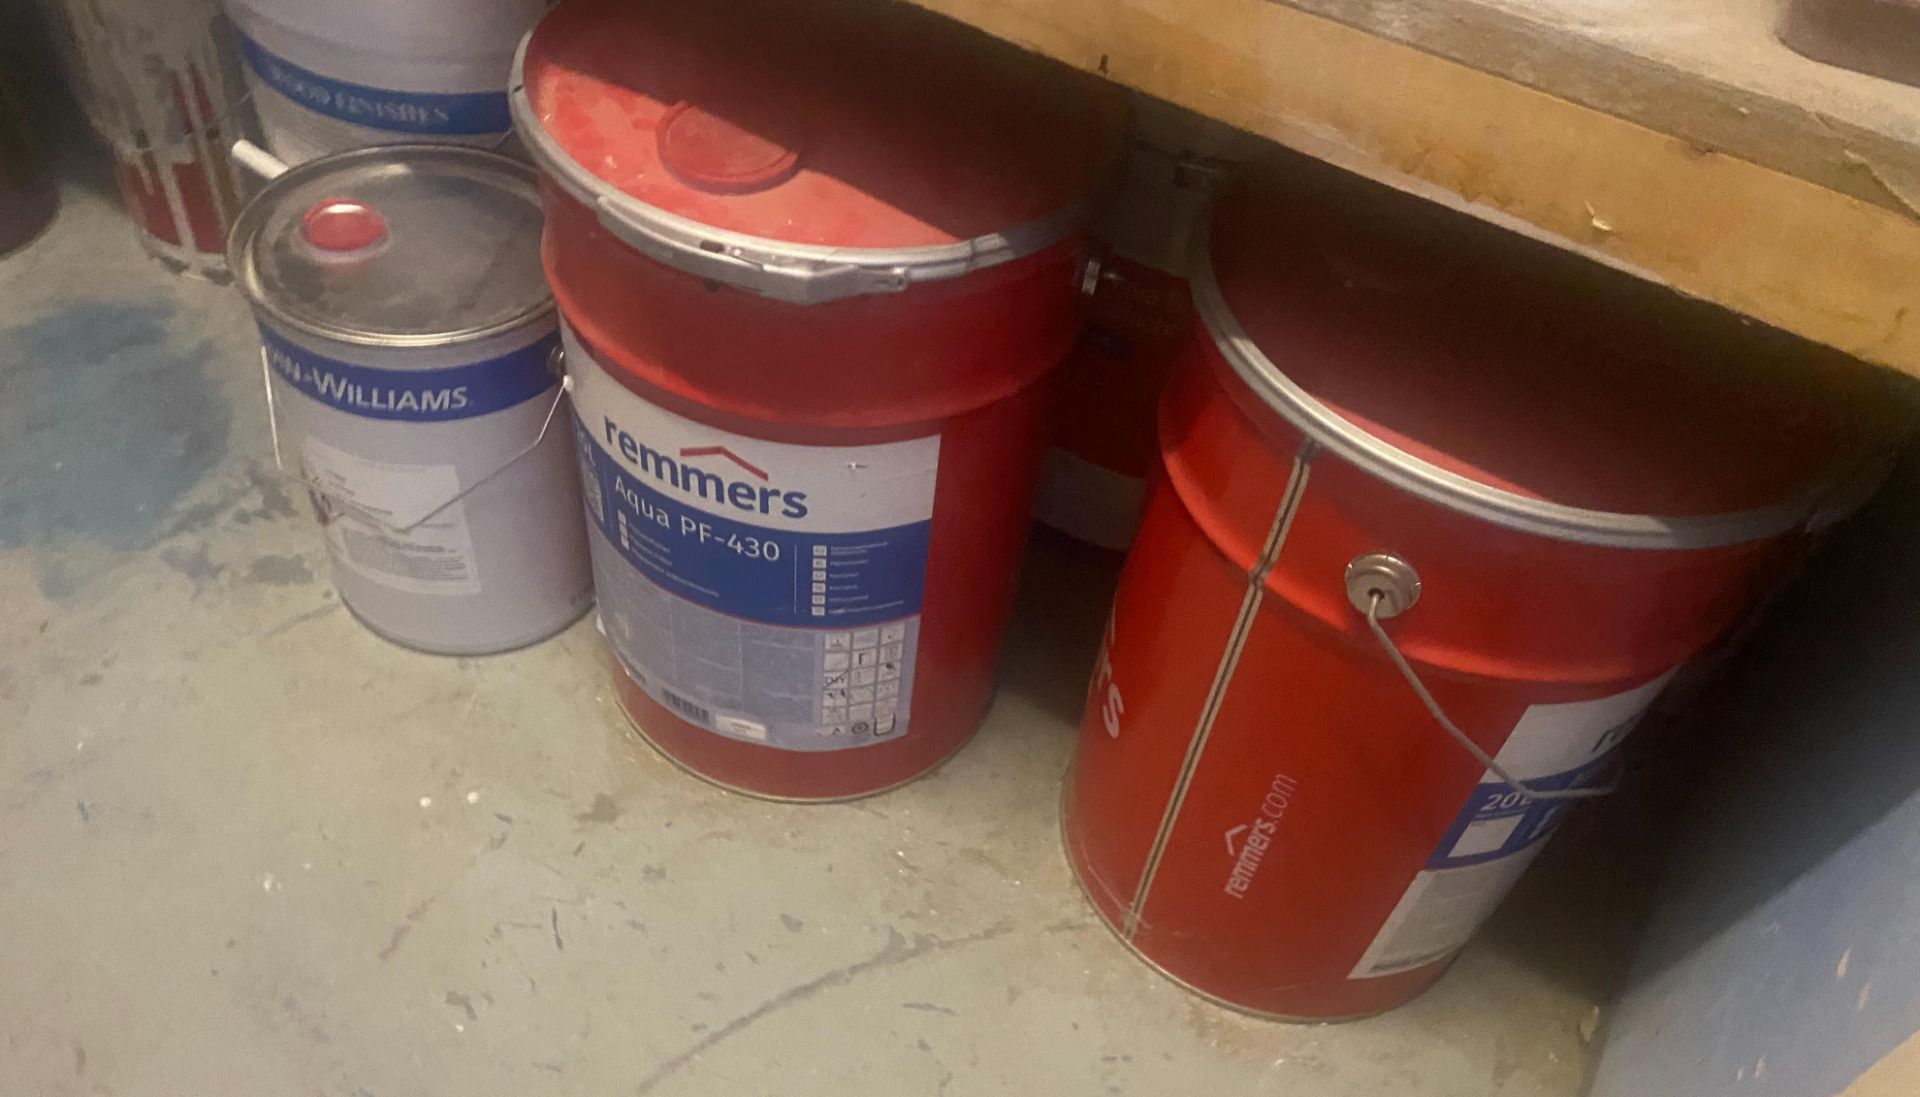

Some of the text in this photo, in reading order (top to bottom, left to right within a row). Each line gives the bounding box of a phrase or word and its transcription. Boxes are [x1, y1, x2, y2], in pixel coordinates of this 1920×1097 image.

[604, 416, 809, 519] remmers
[614, 475, 671, 529] Aqua
[680, 514, 780, 562] PF-430
[1223, 773, 1297, 899] remmers.com
